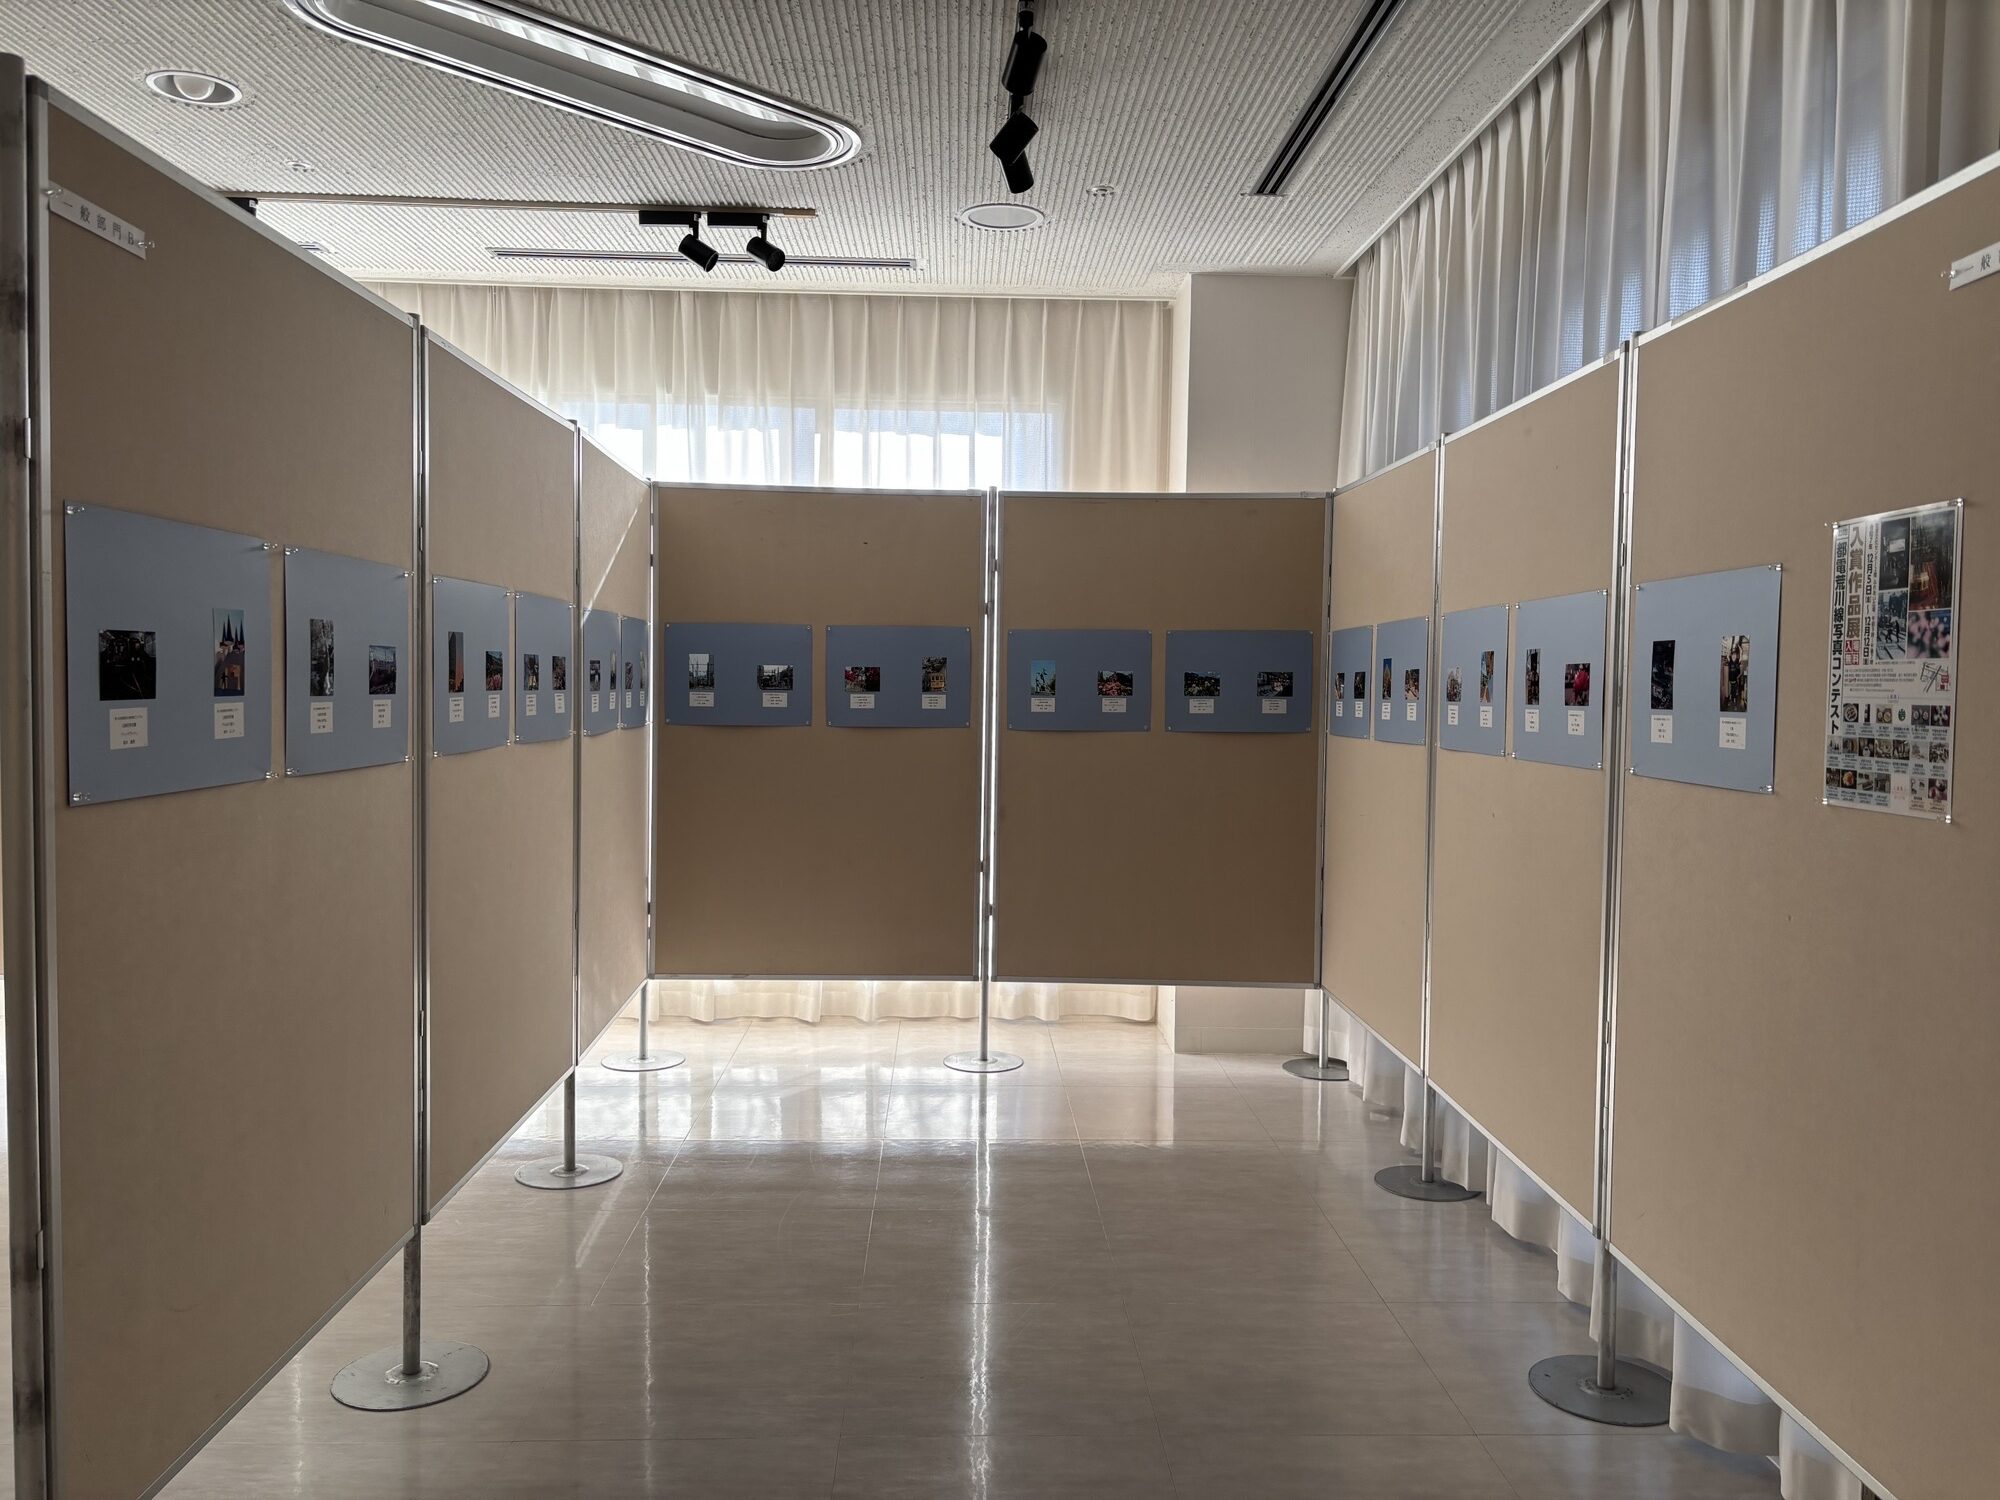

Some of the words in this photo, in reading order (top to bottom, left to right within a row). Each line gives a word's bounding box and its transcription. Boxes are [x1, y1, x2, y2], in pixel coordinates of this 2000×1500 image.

[1965, 249, 2000, 272] 一般
[1830, 541, 1847, 735] 都電荒川線写真コンテスト
[1846, 526, 1863, 639] 入賞作品展
